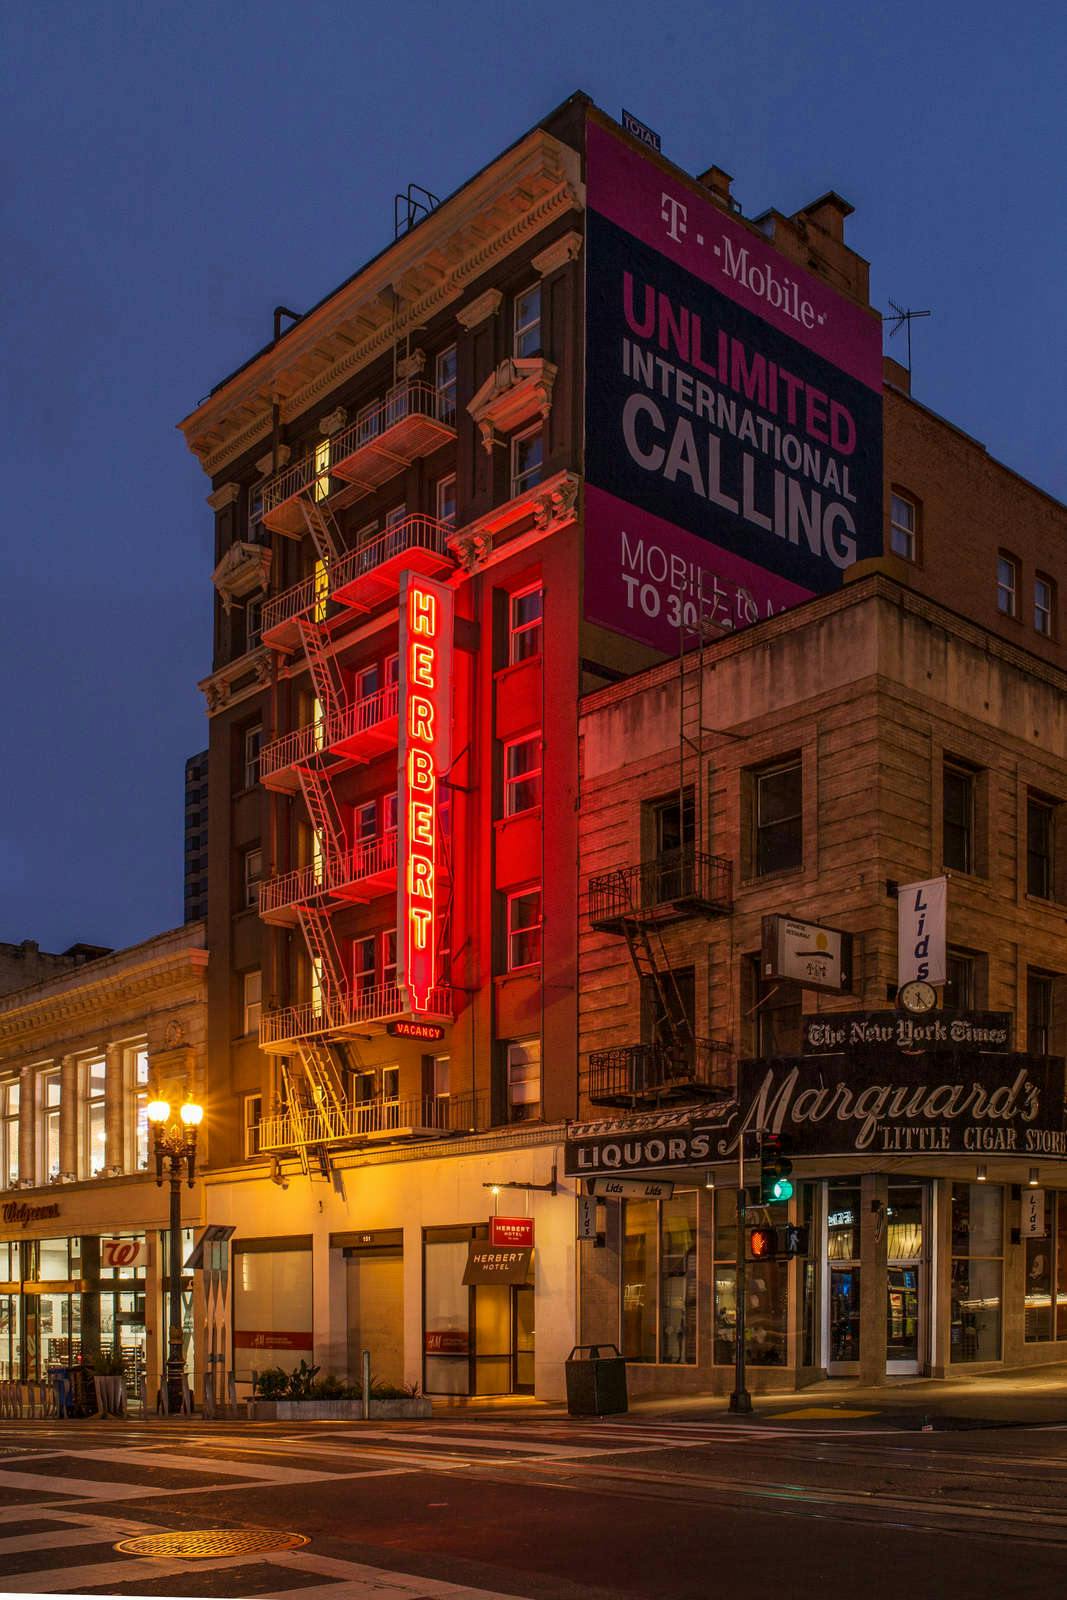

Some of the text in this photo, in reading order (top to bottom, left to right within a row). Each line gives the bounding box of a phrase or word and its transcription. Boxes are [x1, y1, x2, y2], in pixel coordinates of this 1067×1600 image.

[623, 112, 660, 152] TOTAL
[622, 270, 858, 457] UNLIMITED
[621, 336, 857, 504] INTERNATIONAL
[621, 391, 858, 571] CALLING
[621, 572, 660, 618] TO
[410, 589, 436, 950] HERBERT
[914, 888, 929, 981] Lids
[396, 1023, 440, 1039] VACANCY
[808, 1019, 1007, 1047] The New York Times
[576, 1134, 711, 1169] LIQUORS
[963, 1126, 1018, 1151] CIGAR
[605, 1183, 663, 1196] Lids Lids
[496, 1225, 530, 1233] HERBERT
[473, 1252, 525, 1263] HERBERT
[482, 1263, 510, 1272] HOTEL
